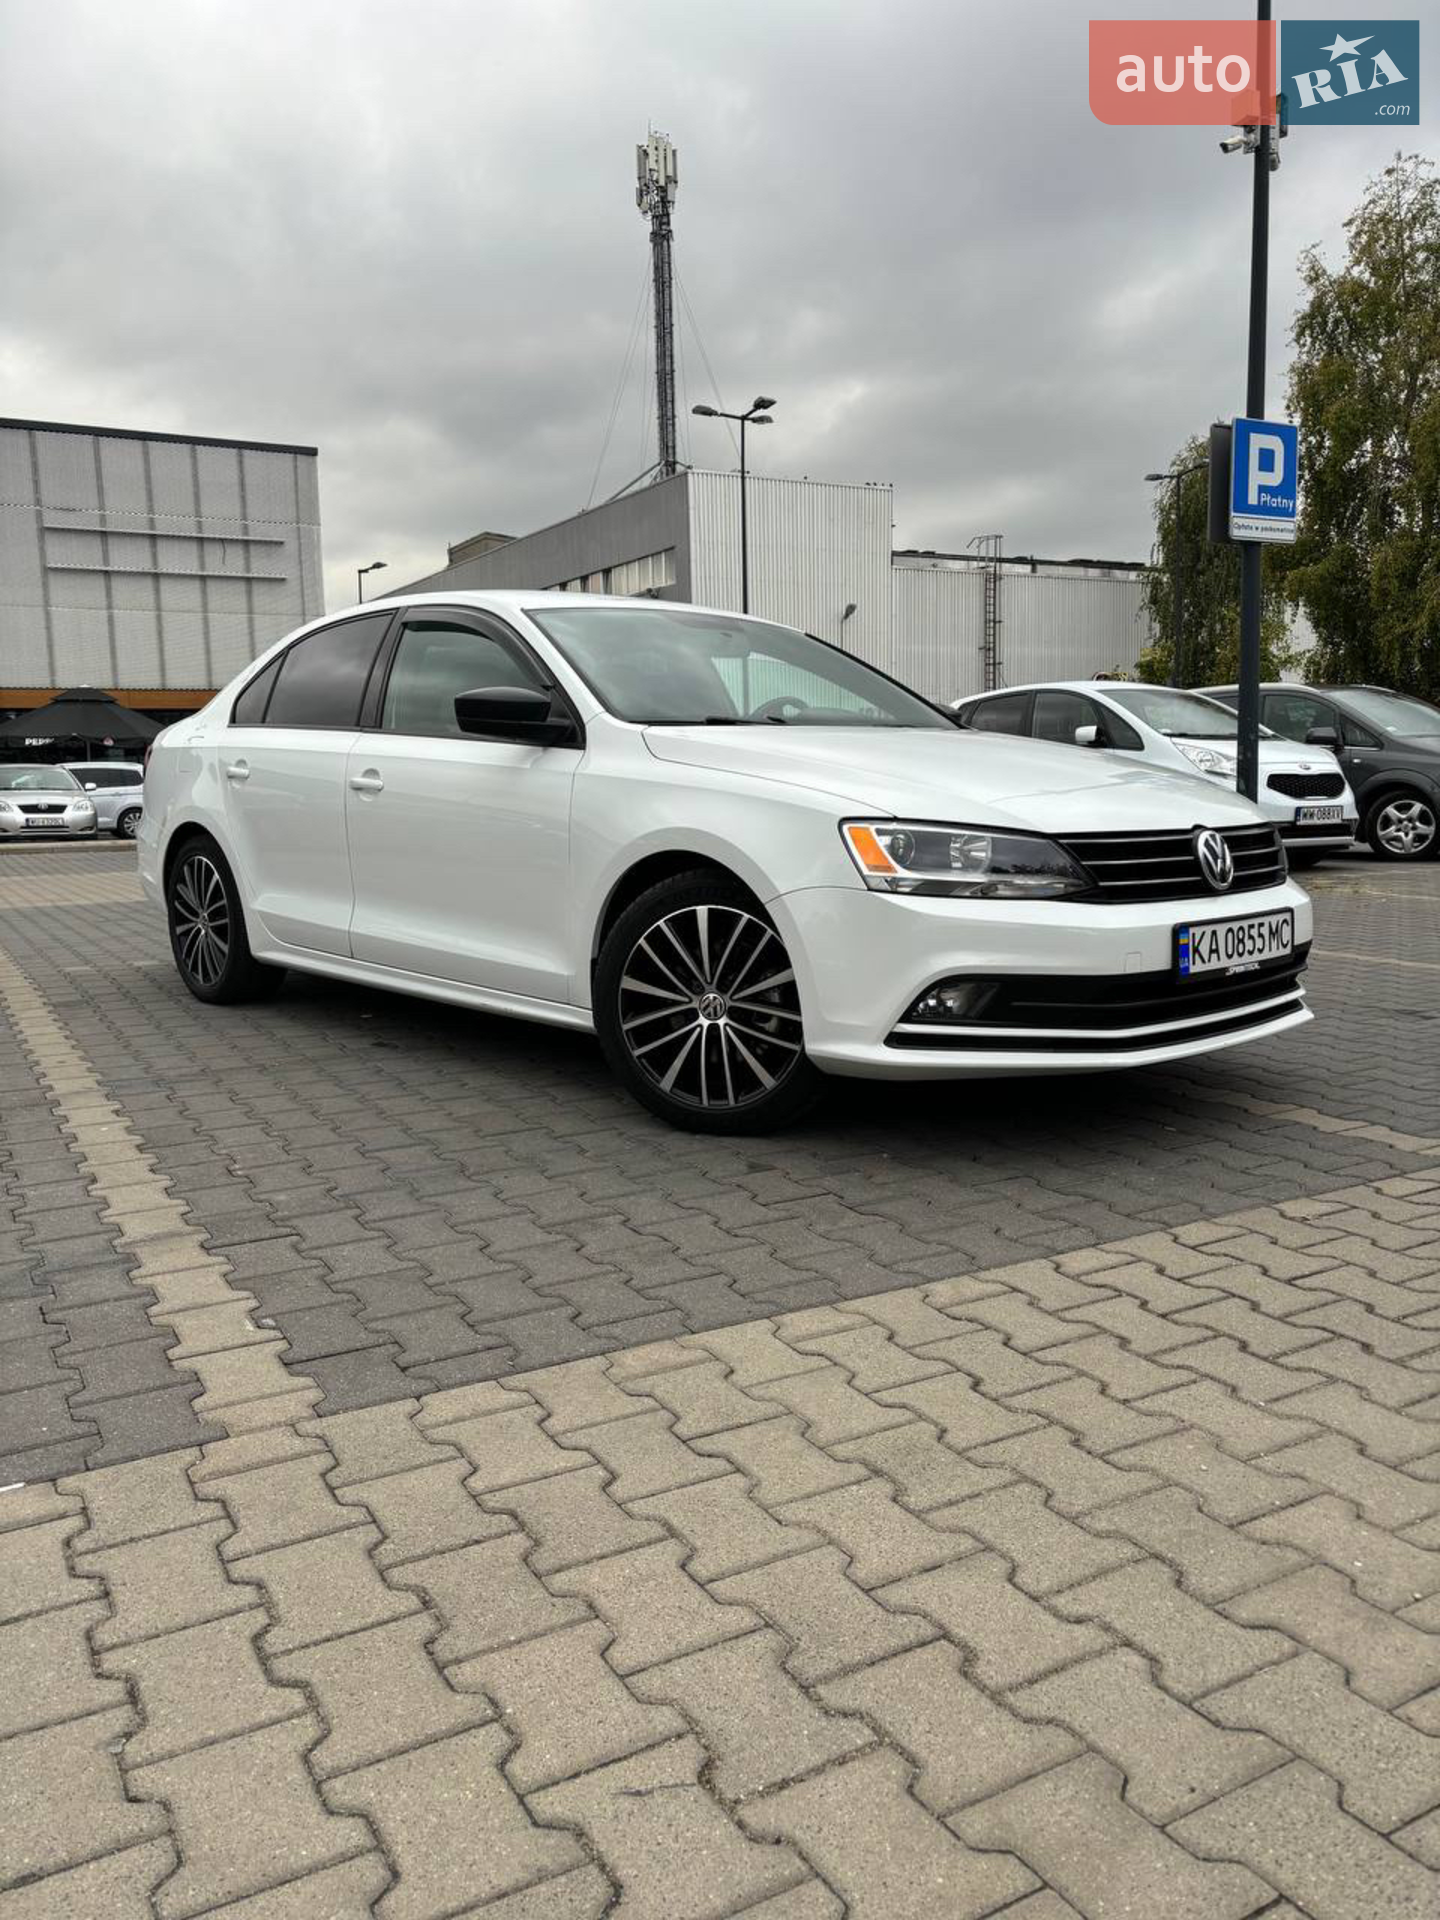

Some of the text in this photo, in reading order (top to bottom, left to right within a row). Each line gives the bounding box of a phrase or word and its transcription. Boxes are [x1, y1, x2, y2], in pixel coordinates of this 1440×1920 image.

[1248, 432, 1285, 505] P
[1260, 493, 1294, 512] Płatny
[1191, 918, 1290, 966] KA 0855 MC
